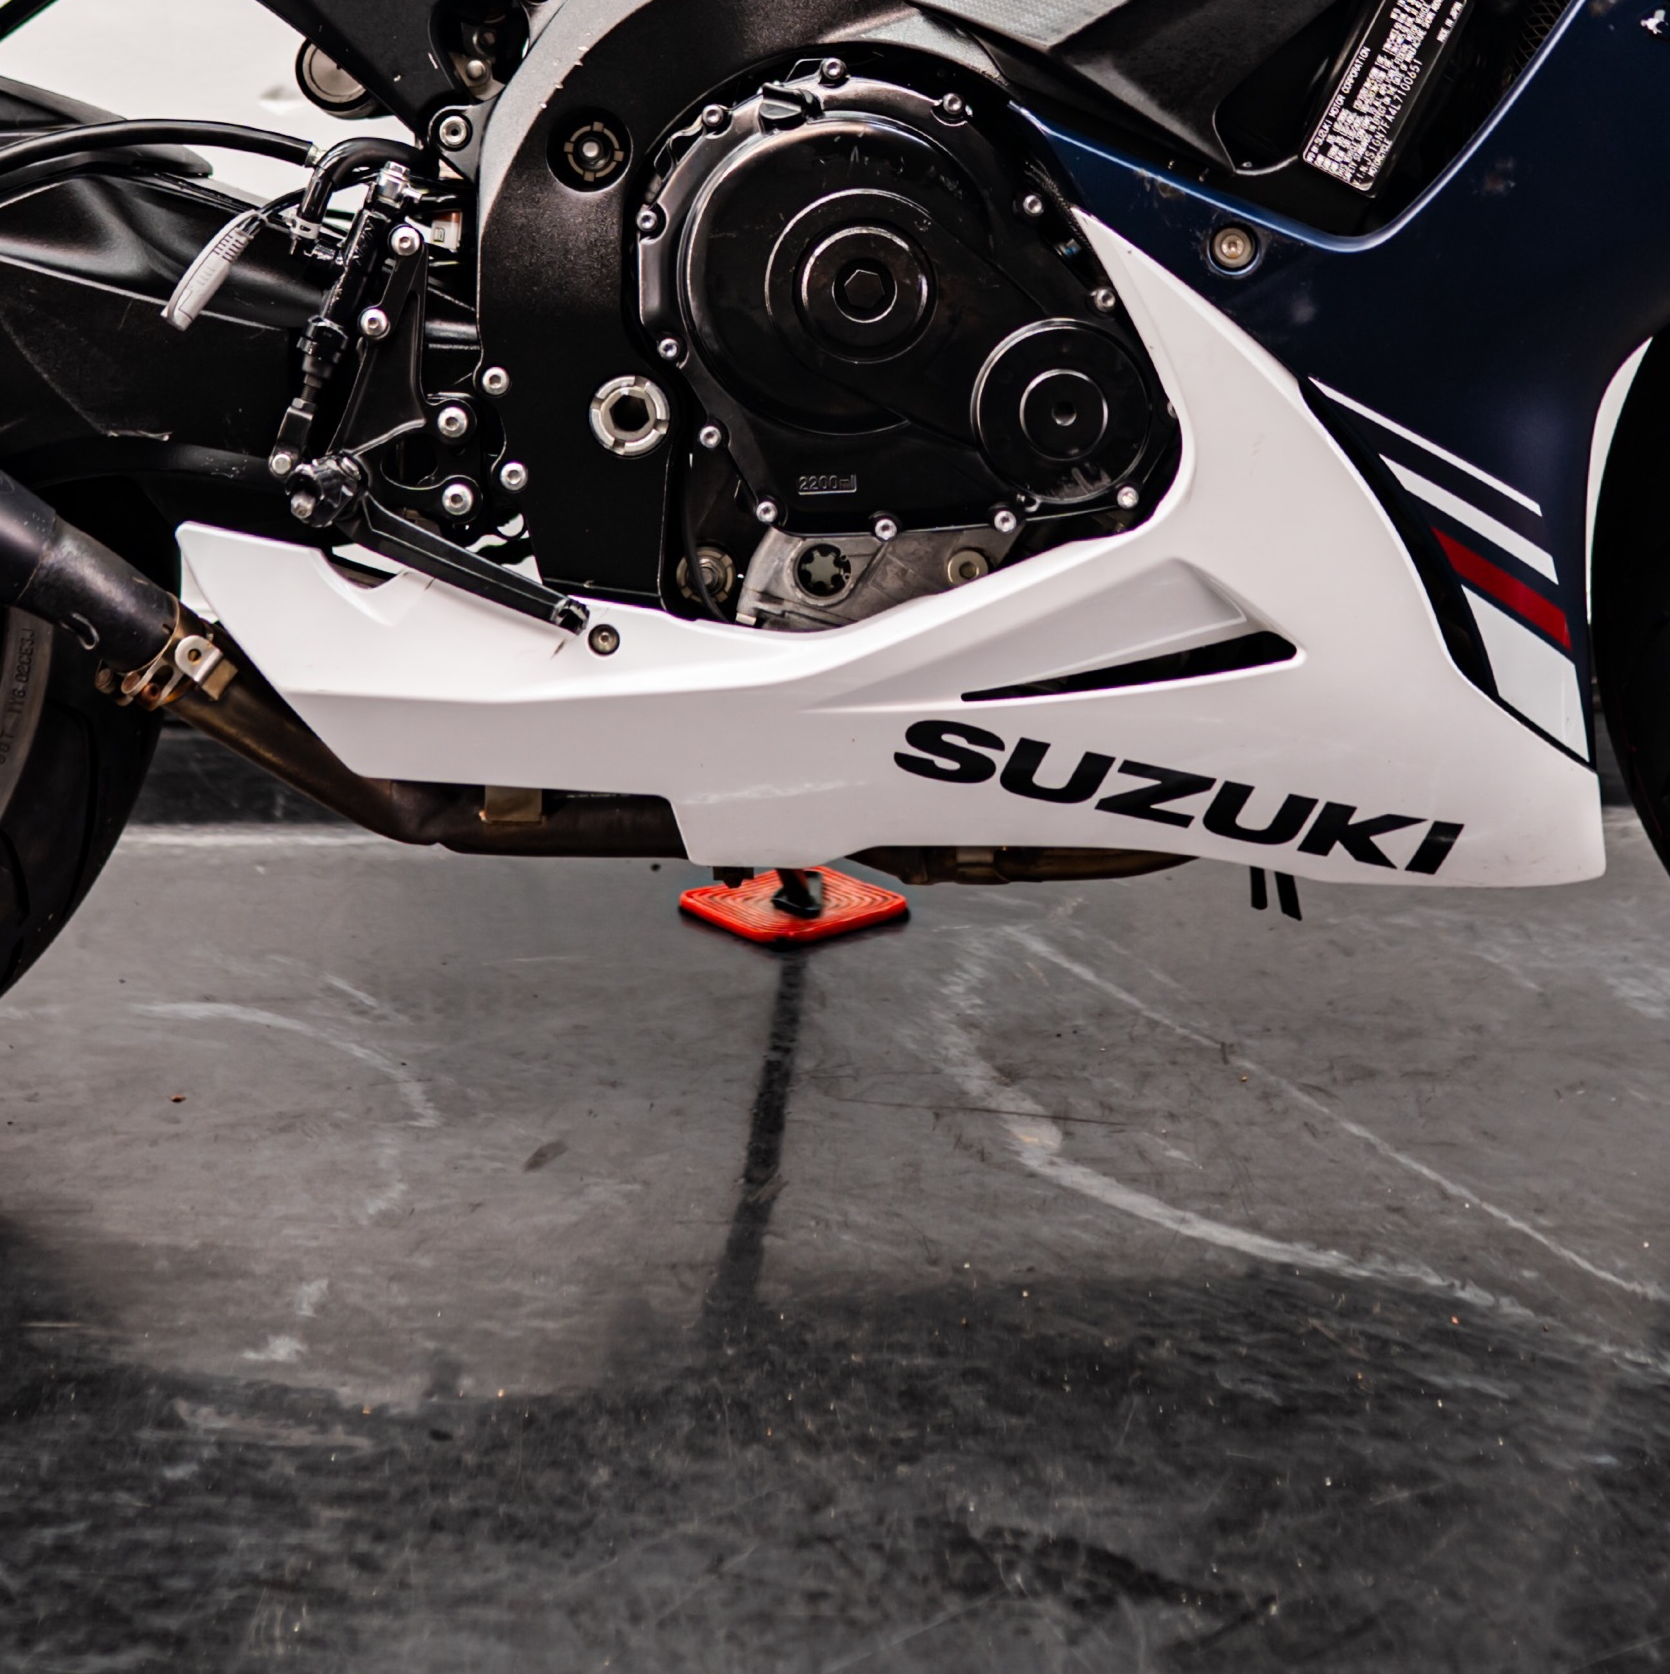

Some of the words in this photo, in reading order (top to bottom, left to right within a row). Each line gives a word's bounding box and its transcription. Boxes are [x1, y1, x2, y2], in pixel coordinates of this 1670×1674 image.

[1328, 94, 1345, 118] MOTOR
[1341, 46, 1370, 94] CORPORATION
[893, 719, 1465, 875] SUZUKI
